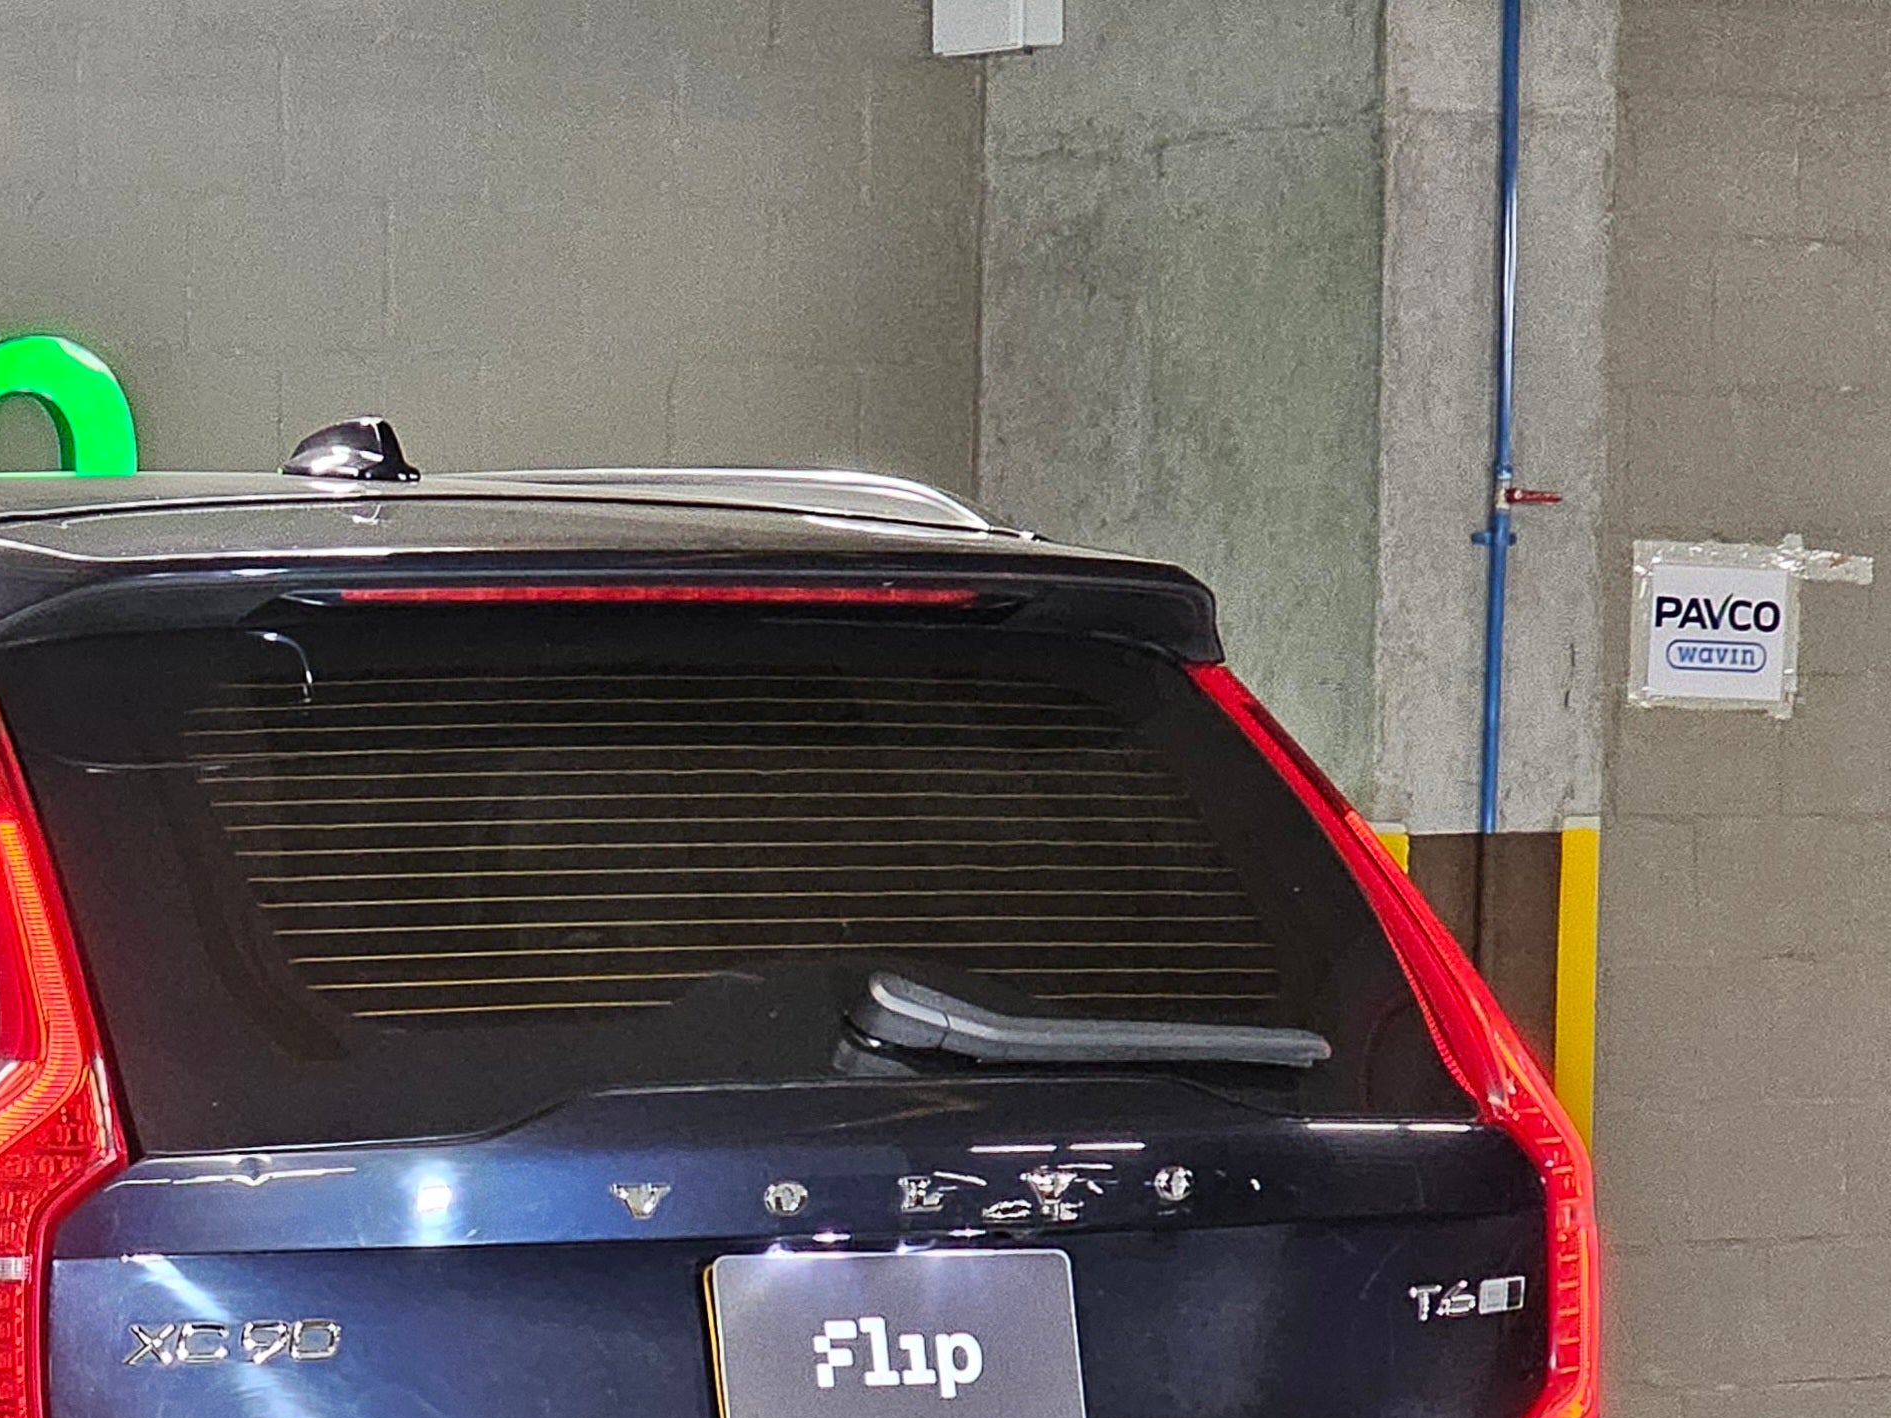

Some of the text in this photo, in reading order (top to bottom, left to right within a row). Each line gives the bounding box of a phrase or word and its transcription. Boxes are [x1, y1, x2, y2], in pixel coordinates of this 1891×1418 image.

[1655, 593, 1780, 632] PAVCO
[1677, 646, 1755, 666] wavin
[609, 1165, 1195, 1220] VOLVO
[1409, 1280, 1476, 1321] T6
[813, 1316, 983, 1399] Flip
